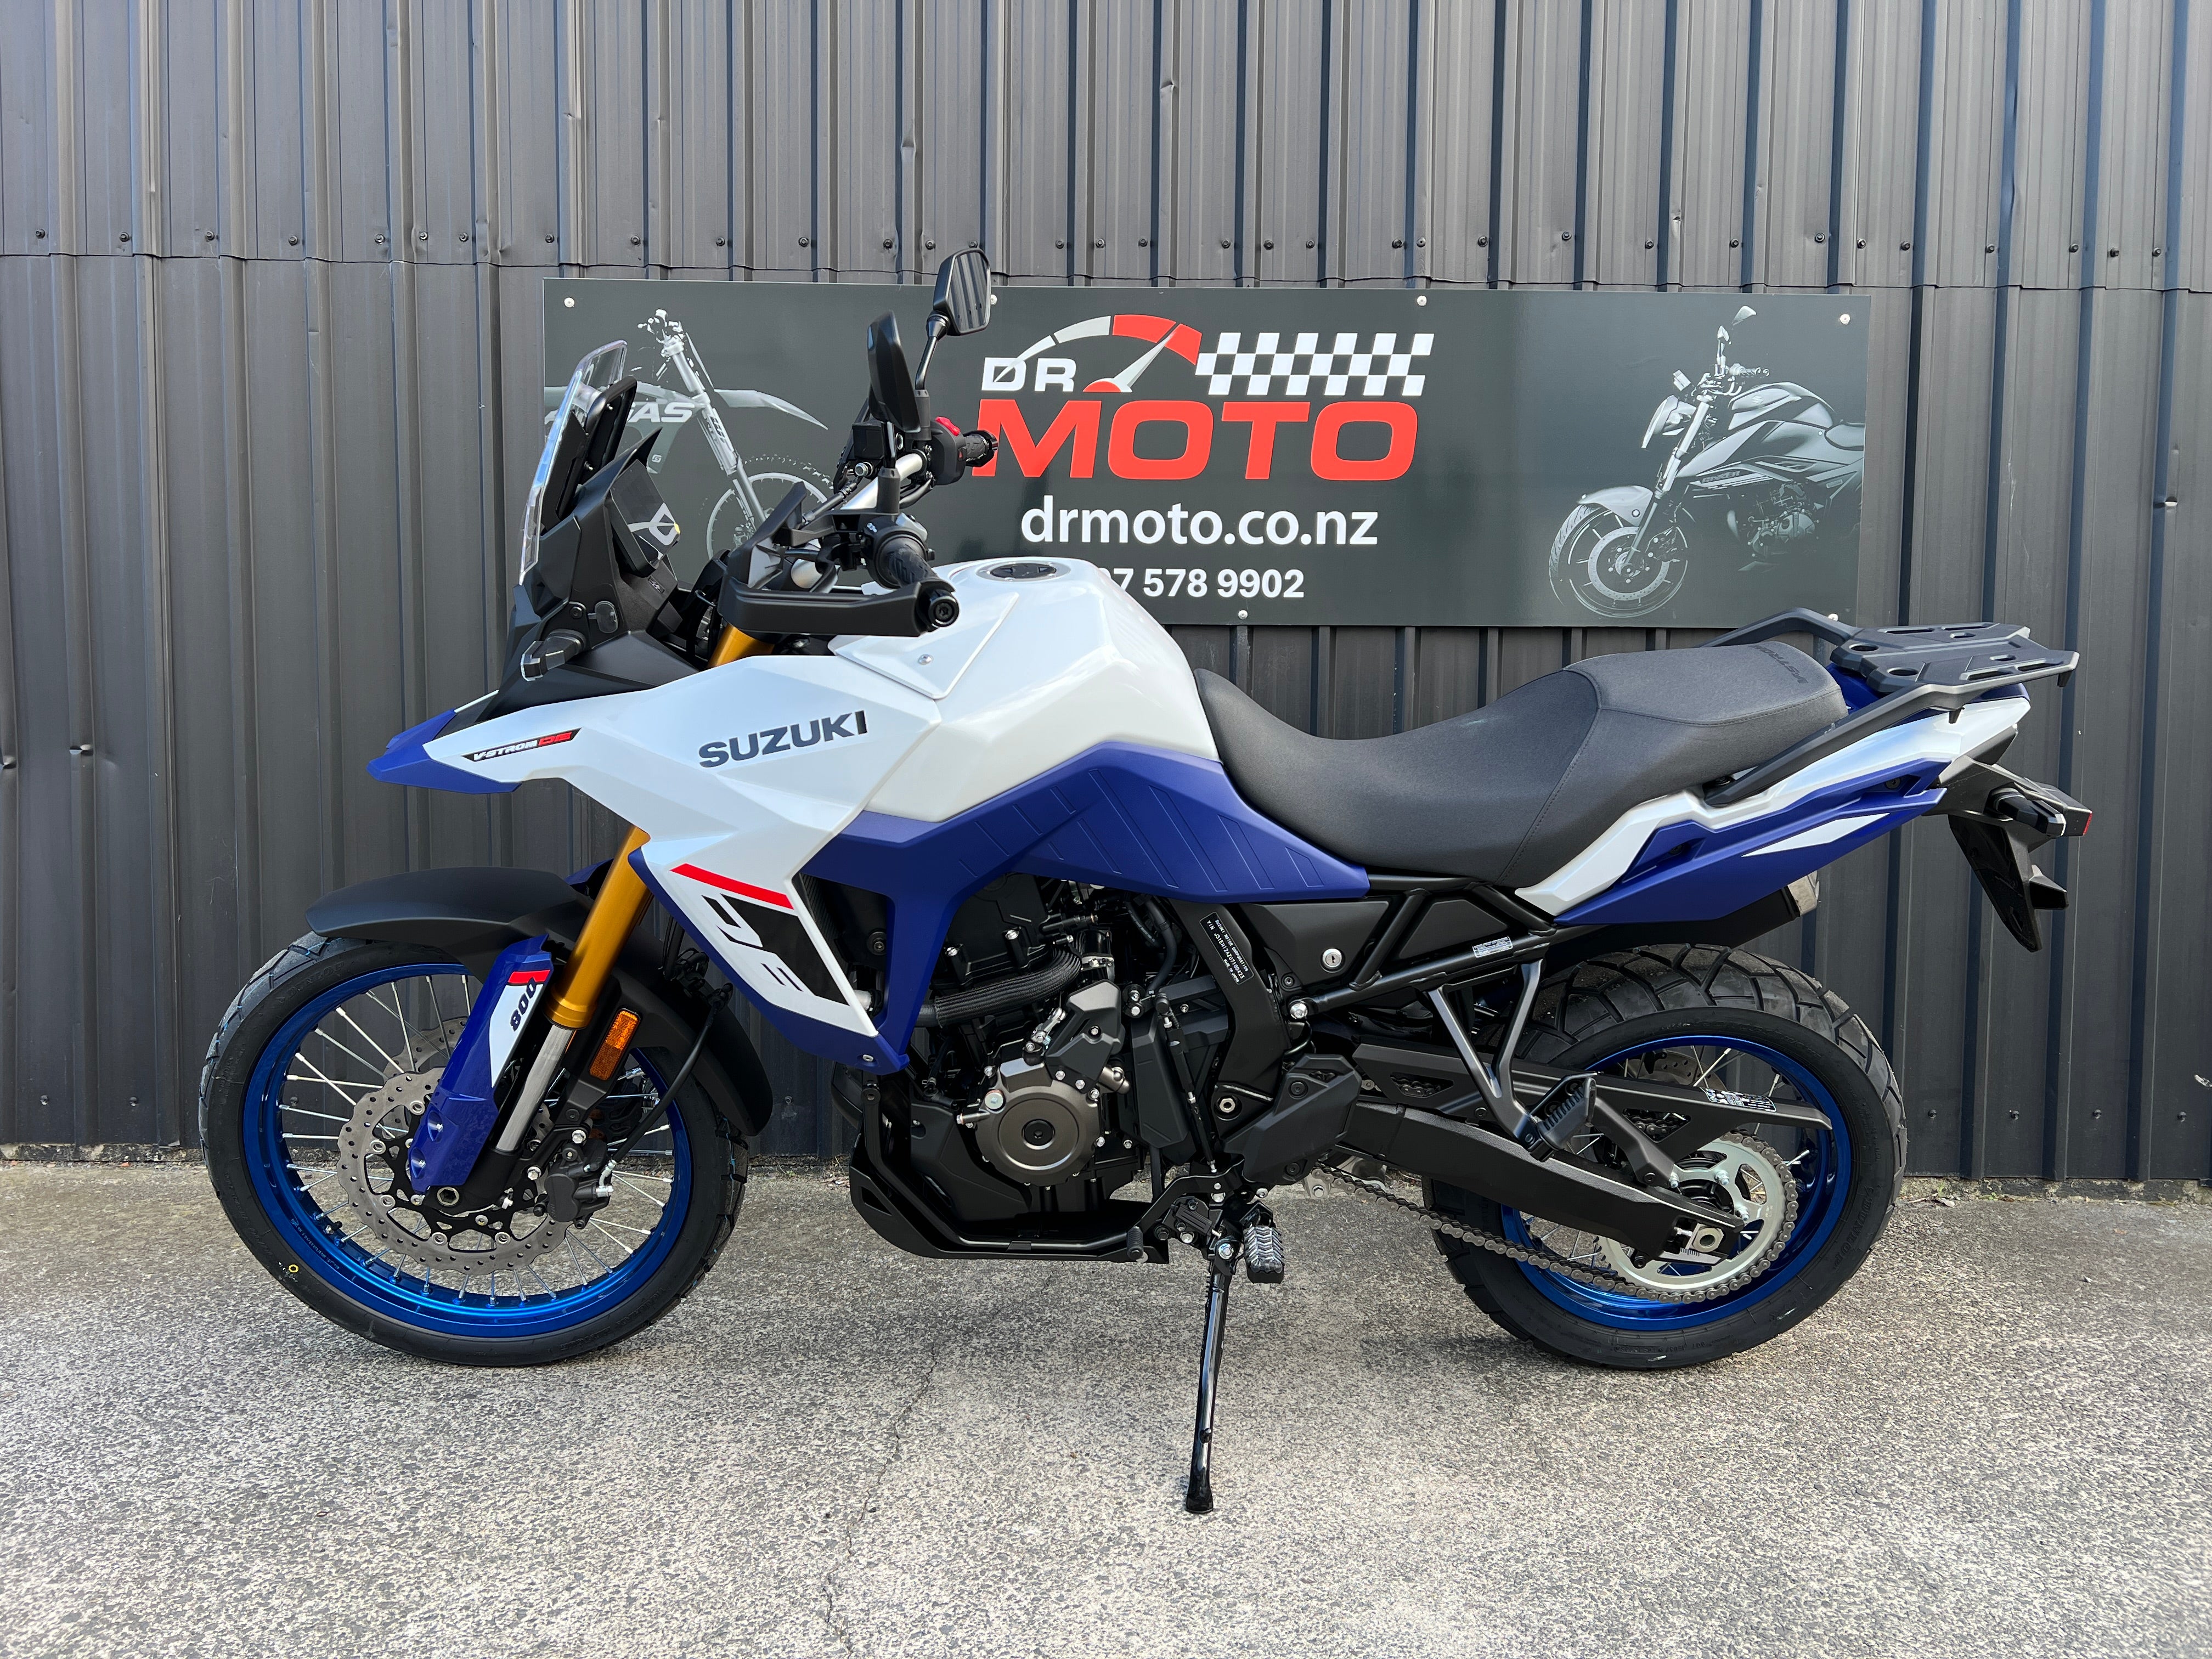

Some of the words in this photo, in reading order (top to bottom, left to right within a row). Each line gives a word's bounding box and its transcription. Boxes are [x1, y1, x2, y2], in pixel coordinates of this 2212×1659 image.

[981, 357, 1077, 392] DR
[972, 398, 1418, 481] MOTO
[1021, 495, 1379, 545] drmoto.co.nz
[1143, 568, 1208, 597] 578
[1217, 568, 1305, 599] 9902
[473, 740, 538, 761] V-STROM
[538, 731, 573, 746] DE
[698, 710, 869, 768] SUZUKI
[1207, 919, 1215, 930] VIN
[510, 976, 537, 1032] 800
